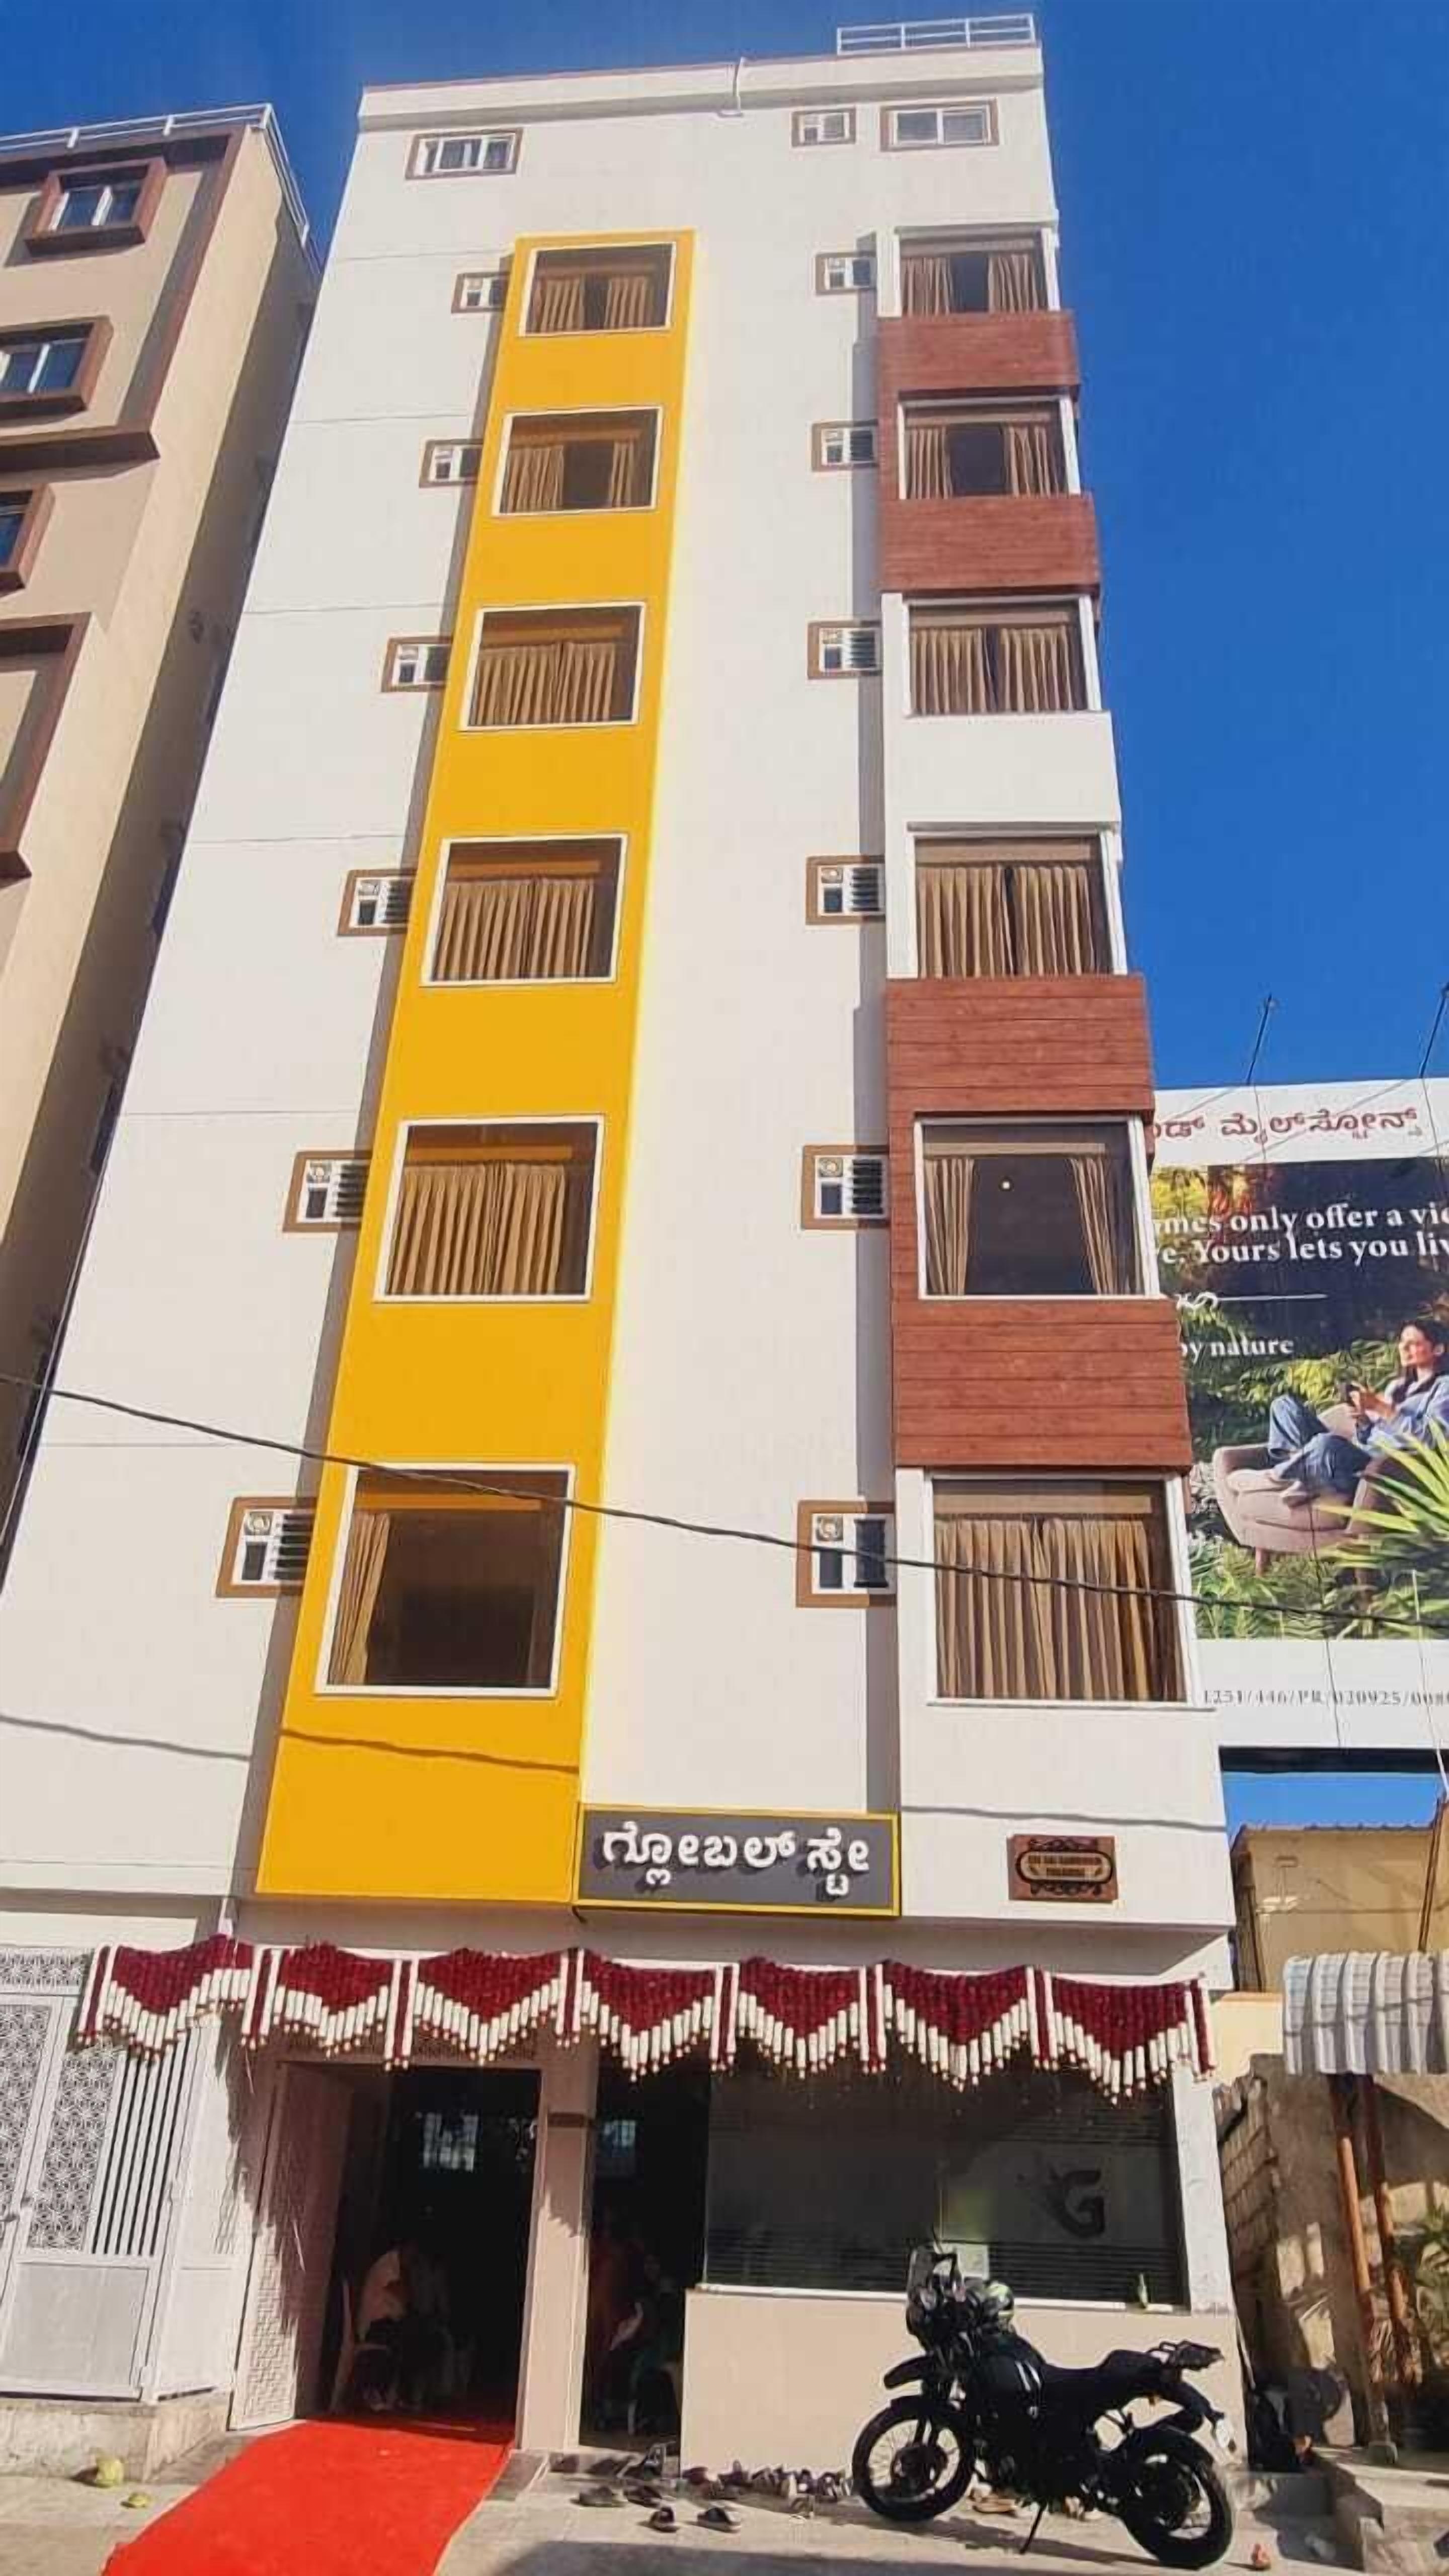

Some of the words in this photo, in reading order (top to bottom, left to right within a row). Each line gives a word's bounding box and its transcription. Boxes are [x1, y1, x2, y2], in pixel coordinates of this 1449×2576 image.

[1230, 1204, 1298, 1235] only
[1306, 1203, 1378, 1228] offer
[1386, 1209, 1403, 1226] a
[1191, 1239, 1280, 1263] Yours
[1288, 1232, 1342, 1260] lets
[1349, 1240, 1408, 1266] you
[1211, 1330, 1294, 1356] nature
[602, 1820, 796, 1886] ಗ್ಲೋಬಲ್
[807, 1827, 870, 1896] ಸ್ಟೇ
